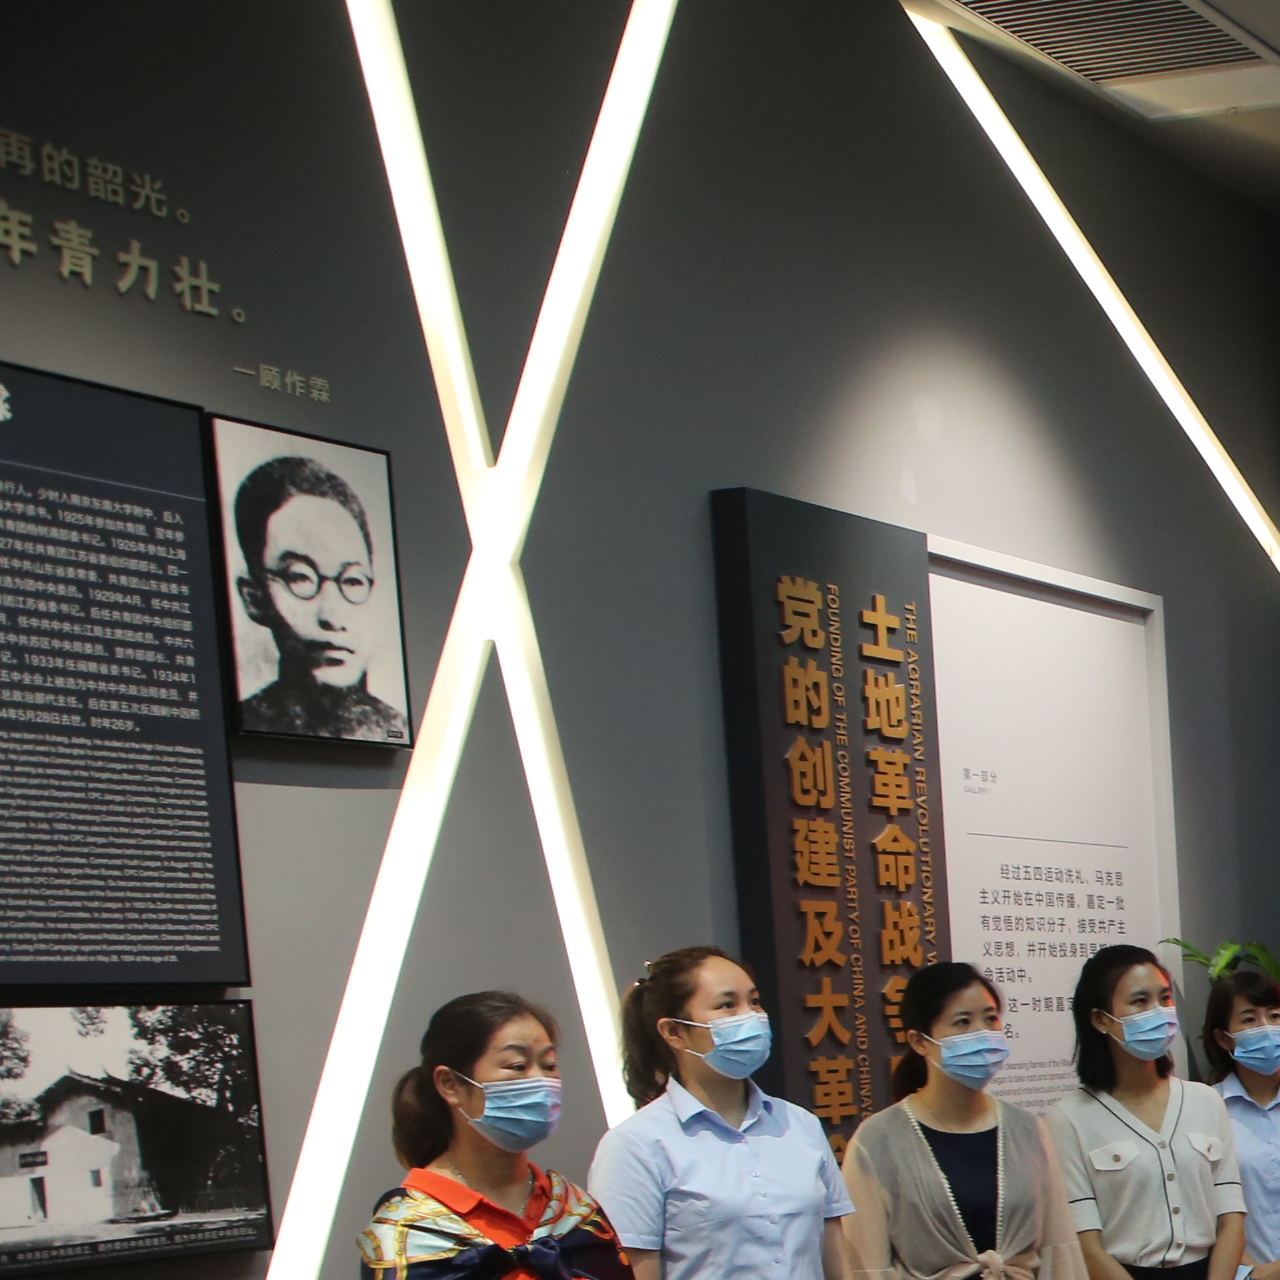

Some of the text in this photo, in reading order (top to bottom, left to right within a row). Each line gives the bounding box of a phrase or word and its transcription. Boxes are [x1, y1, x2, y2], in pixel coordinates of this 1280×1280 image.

[826, 583, 843, 678] FOUNDING
[904, 602, 917, 644] THE
[832, 682, 846, 708] OF
[907, 648, 925, 762] AGRARIAN
[834, 711, 848, 749] THE
[963, 768, 998, 784] 第一部分
[836, 750, 856, 861] COMMUNIST
[915, 767, 938, 946] REVOLUTIONARY
[1000, 864, 1124, 887] 经过五四运动洗礼，马克思
[844, 865, 860, 925] PARTY
[979, 888, 1125, 911] 主义开始在中国传播，嘉定一批
[847, 925, 862, 951] OF
[980, 915, 1127, 935] 有觉悟的知识分子，接受共产主
[850, 953, 866, 1009] CHINA
[855, 1013, 869, 1050] AND
